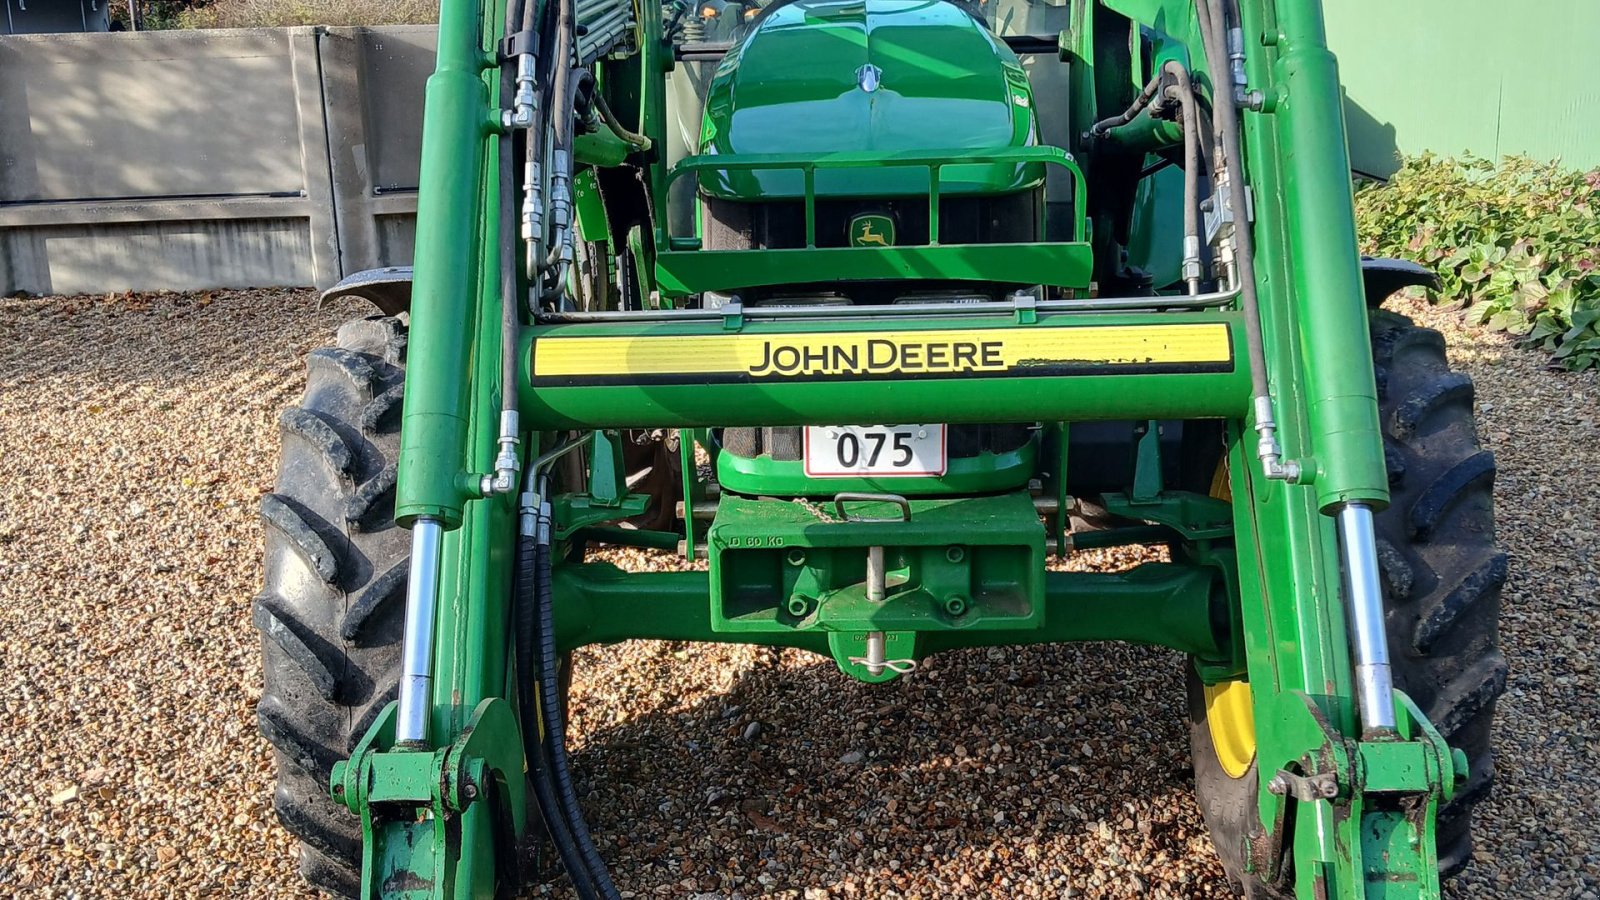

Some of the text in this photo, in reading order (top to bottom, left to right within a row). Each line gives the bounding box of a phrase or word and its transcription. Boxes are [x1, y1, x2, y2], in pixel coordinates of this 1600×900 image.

[749, 339, 1004, 372] JOHN DEERE
[836, 431, 914, 468] 075
